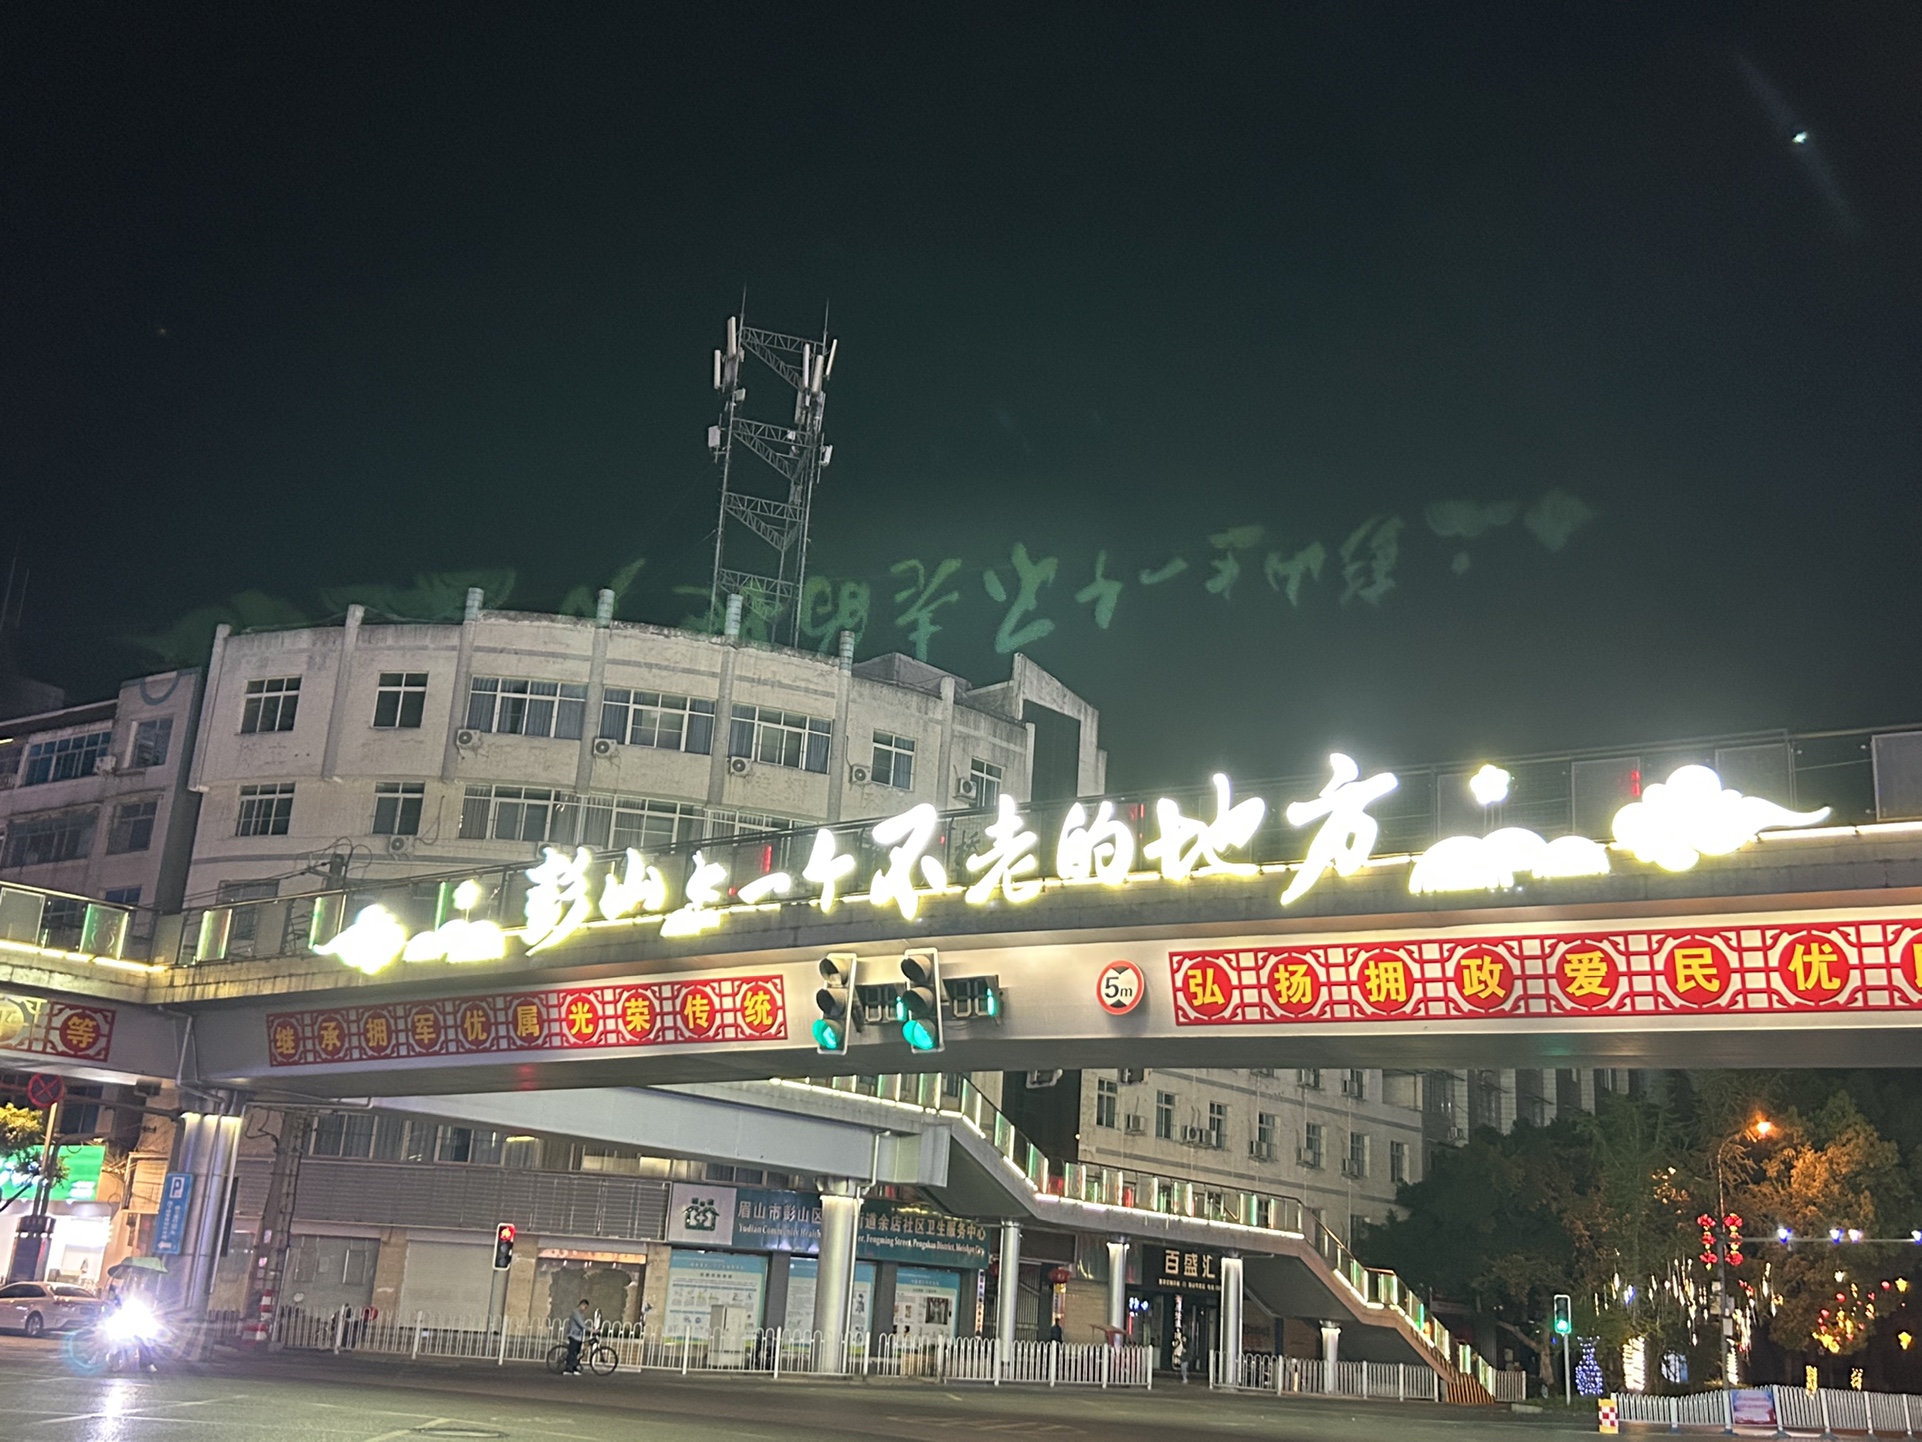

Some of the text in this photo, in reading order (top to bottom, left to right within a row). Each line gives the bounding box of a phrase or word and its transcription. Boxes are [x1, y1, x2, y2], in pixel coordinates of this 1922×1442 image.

[1104, 976, 1134, 999] 5m
[1186, 941, 1922, 1007] 弘扬拥政爱民优
[275, 988, 775, 1056] 继承拥军优属光荣传统
[1164, 1249, 1216, 1279] 百盛汇
